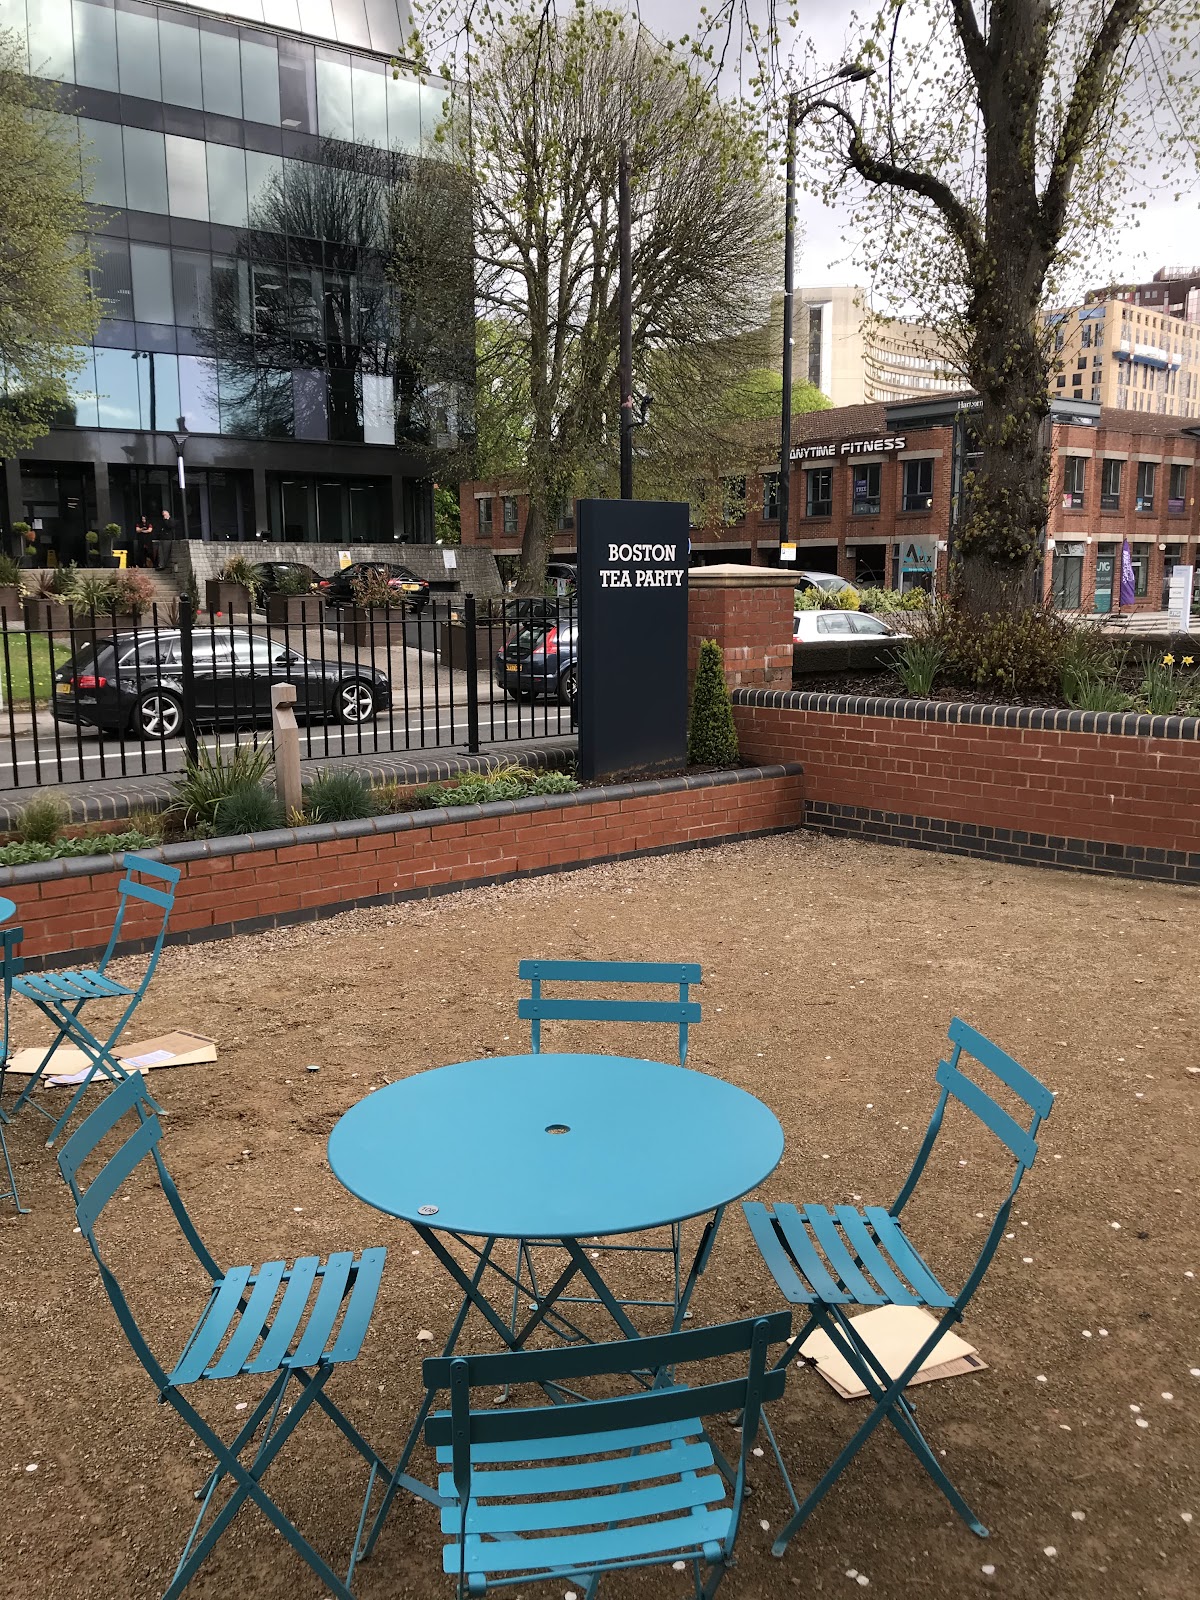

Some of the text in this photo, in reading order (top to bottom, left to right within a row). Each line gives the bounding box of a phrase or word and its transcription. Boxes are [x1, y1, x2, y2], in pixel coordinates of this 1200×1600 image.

[789, 437, 906, 460] ANYTIME FITNESS
[608, 544, 677, 562] BOSTON
[599, 569, 685, 588] TEA PARTY
